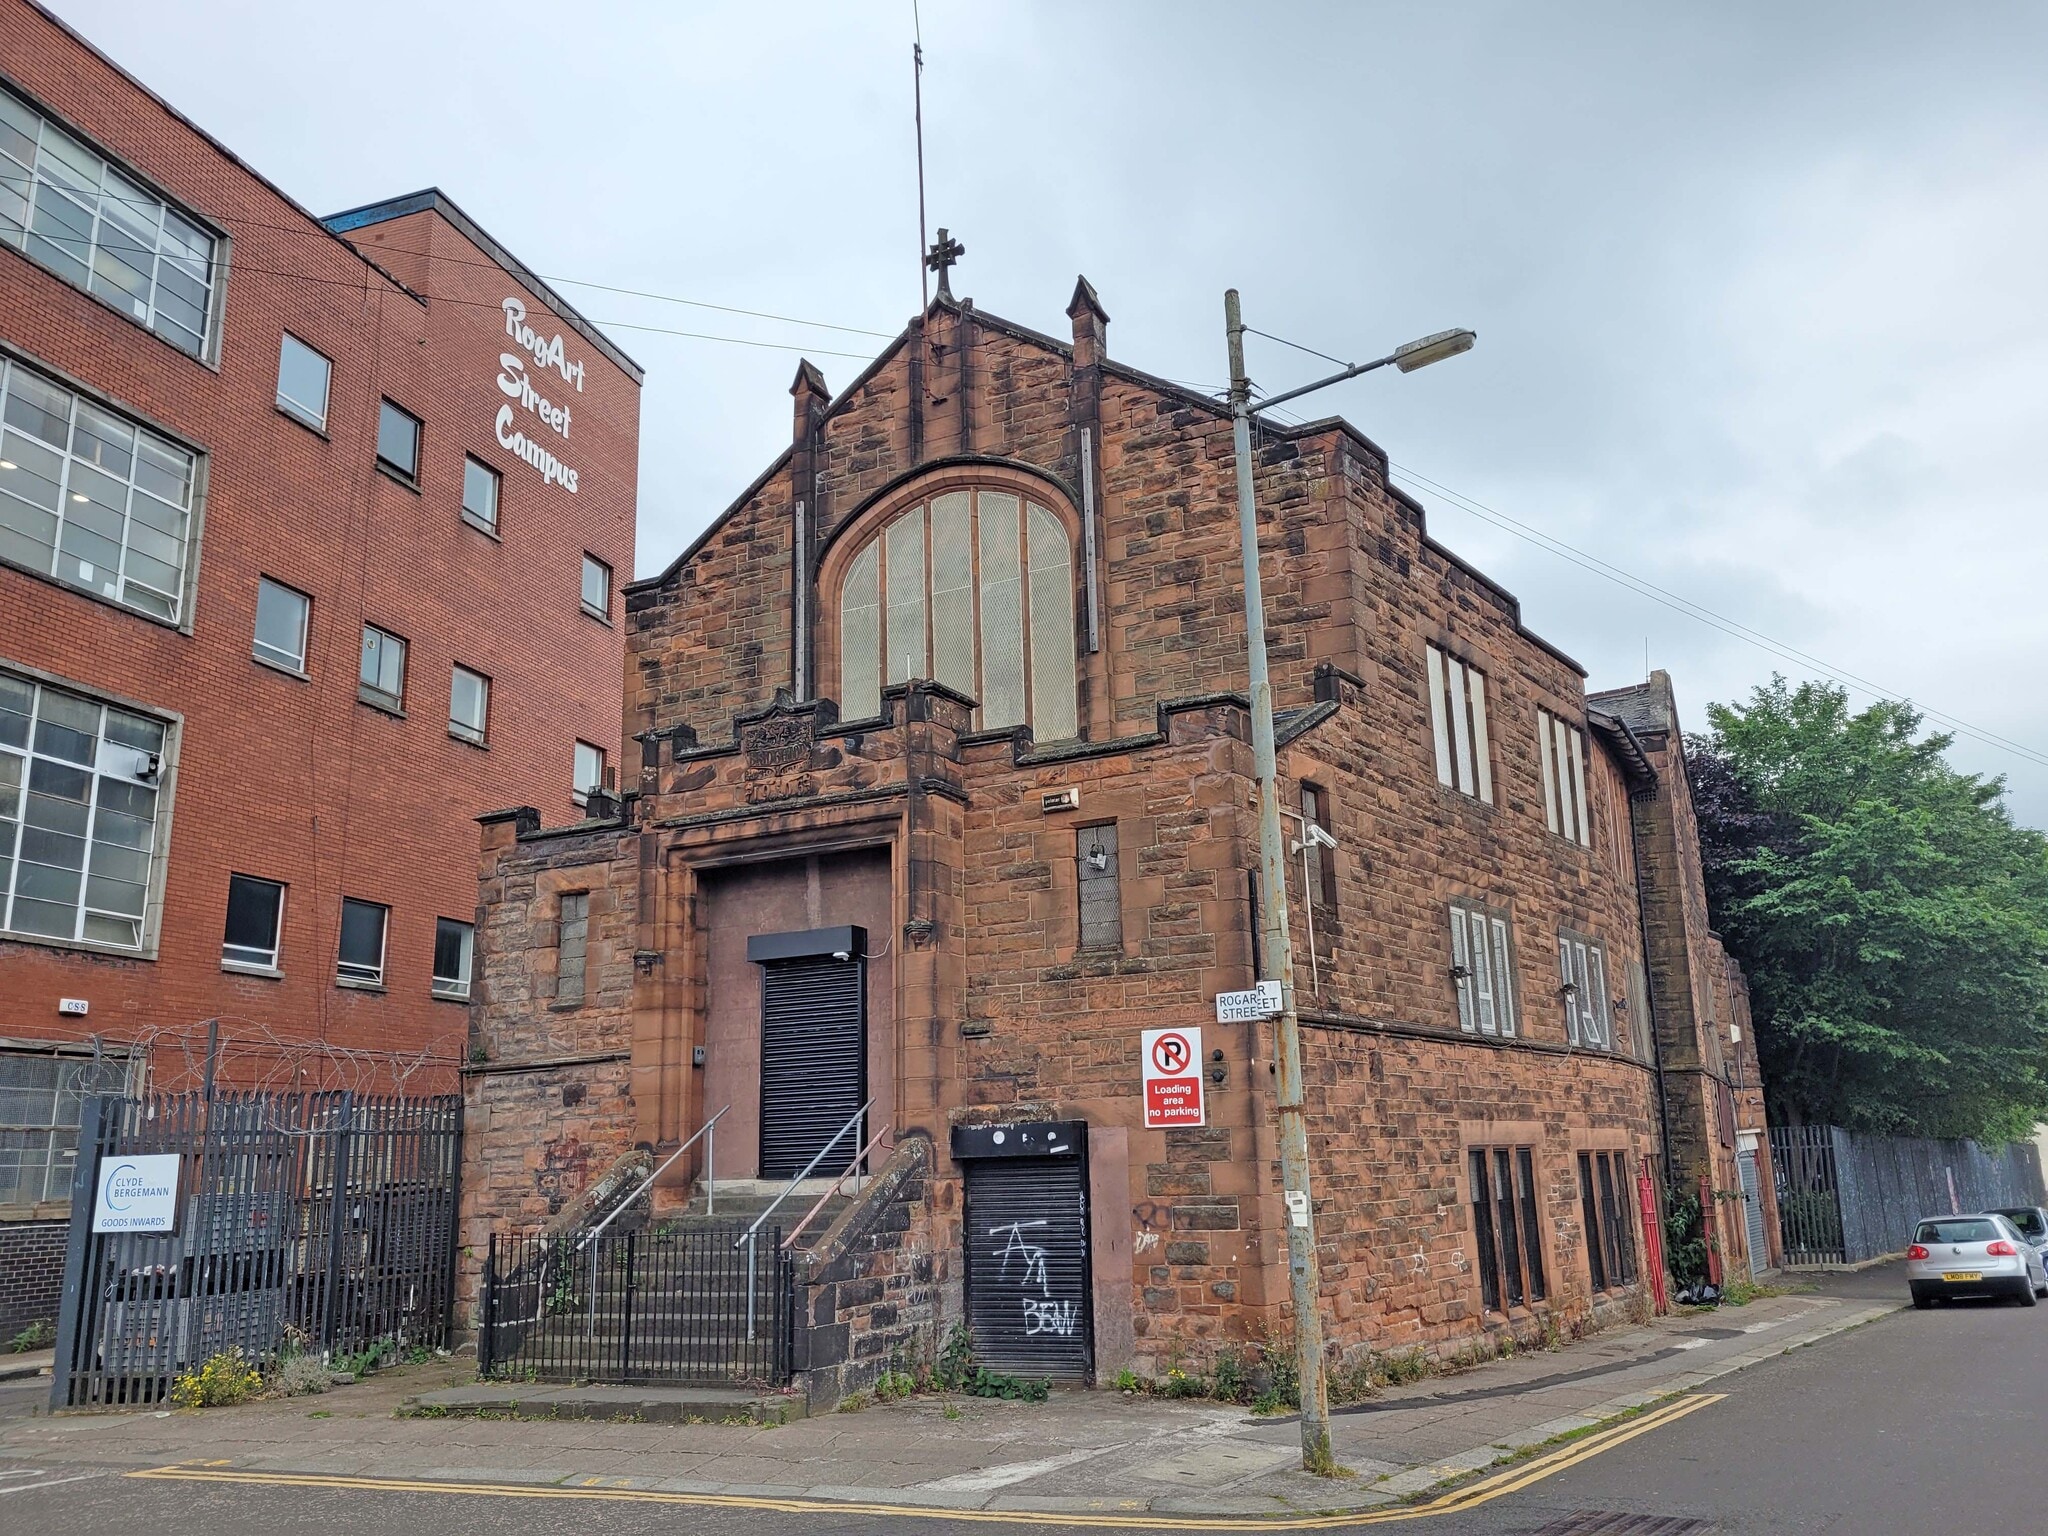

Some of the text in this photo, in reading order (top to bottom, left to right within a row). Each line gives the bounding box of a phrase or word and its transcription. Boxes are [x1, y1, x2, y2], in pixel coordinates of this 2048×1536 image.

[497, 353, 572, 439] Street
[496, 404, 579, 493] Campus
[1219, 993, 1257, 1007] ROGAR
[67, 1002, 86, 1012] CSS
[1222, 1006, 1257, 1019] STREE
[1154, 1084, 1191, 1095] Loading
[1163, 1097, 1184, 1105] area
[1149, 1106, 1199, 1118] no parking
[115, 1178, 143, 1187] CLYDE
[114, 1187, 169, 1198] BERGEMANN
[101, 1217, 166, 1227] GOODS INWARDS
